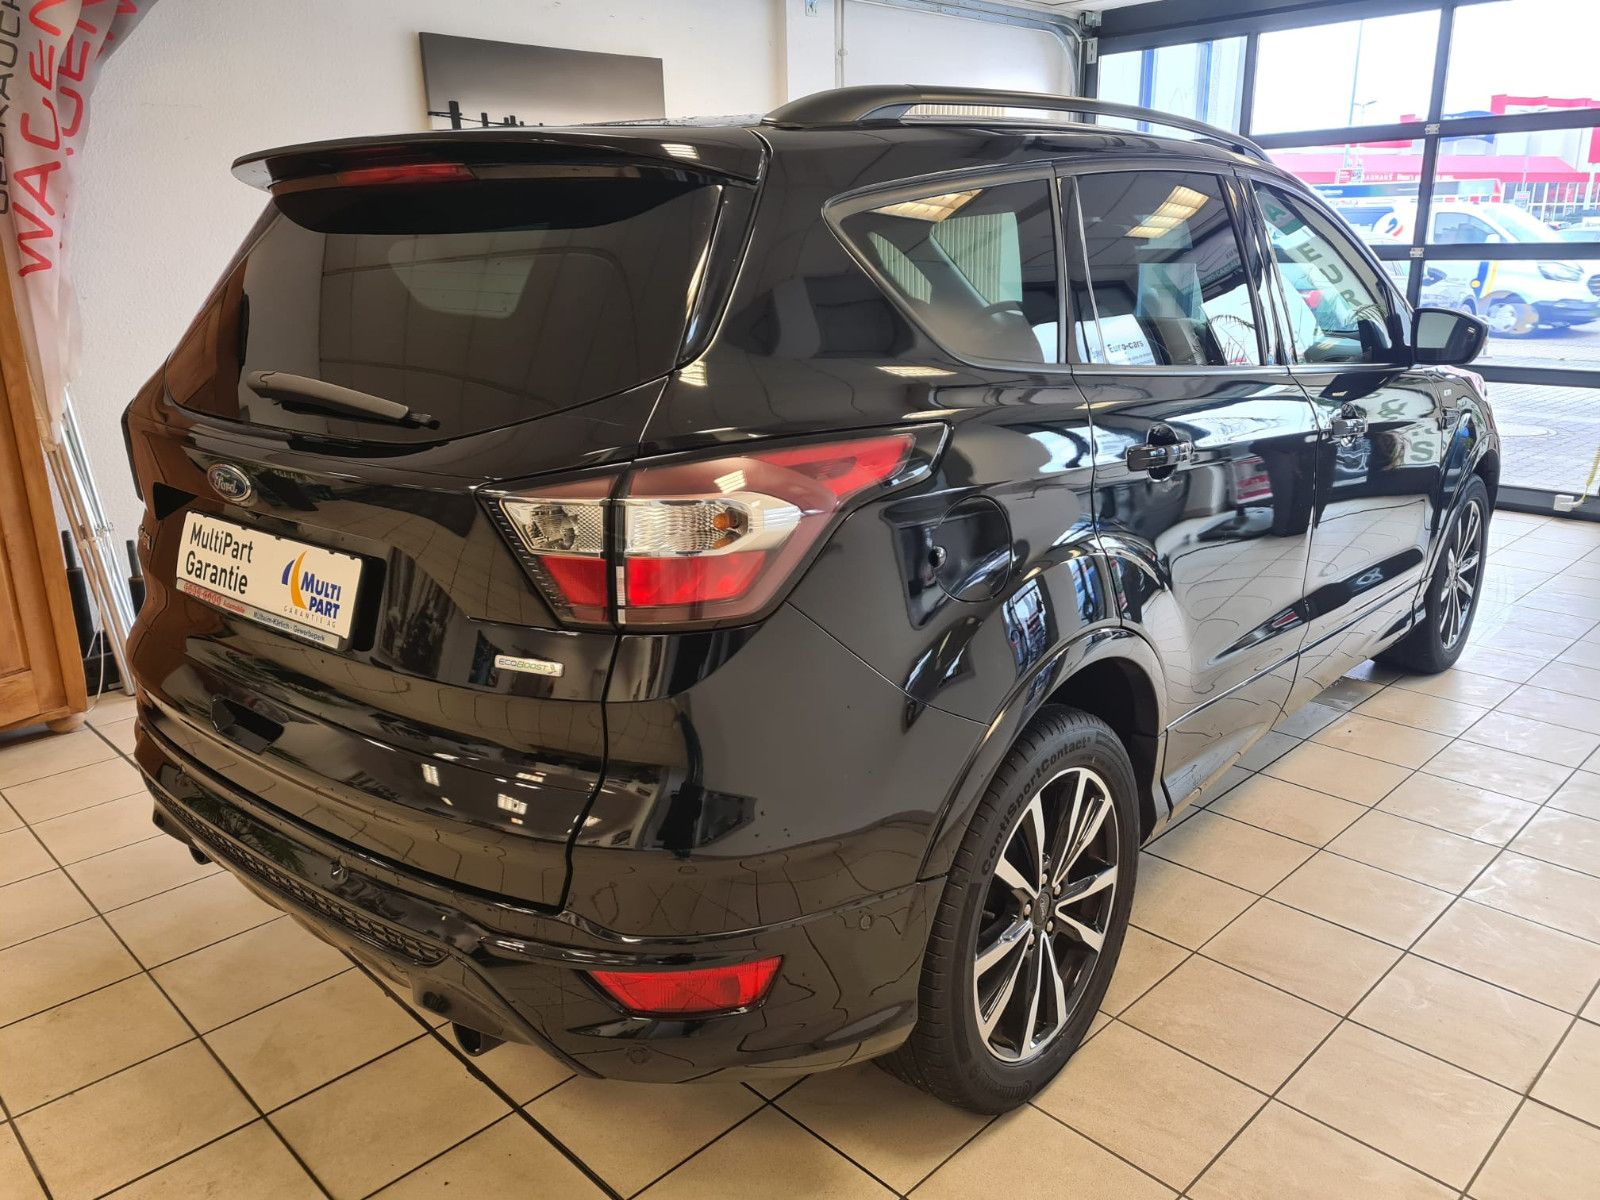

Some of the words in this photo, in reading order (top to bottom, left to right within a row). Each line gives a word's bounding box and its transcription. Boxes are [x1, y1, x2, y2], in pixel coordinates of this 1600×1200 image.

[214, 471, 239, 493] Ford
[190, 521, 254, 564] MultiPart
[185, 550, 249, 595] Garantie
[300, 571, 342, 602] MULTI
[283, 604, 325, 626] GARANTIE
[308, 596, 341, 620] PART
